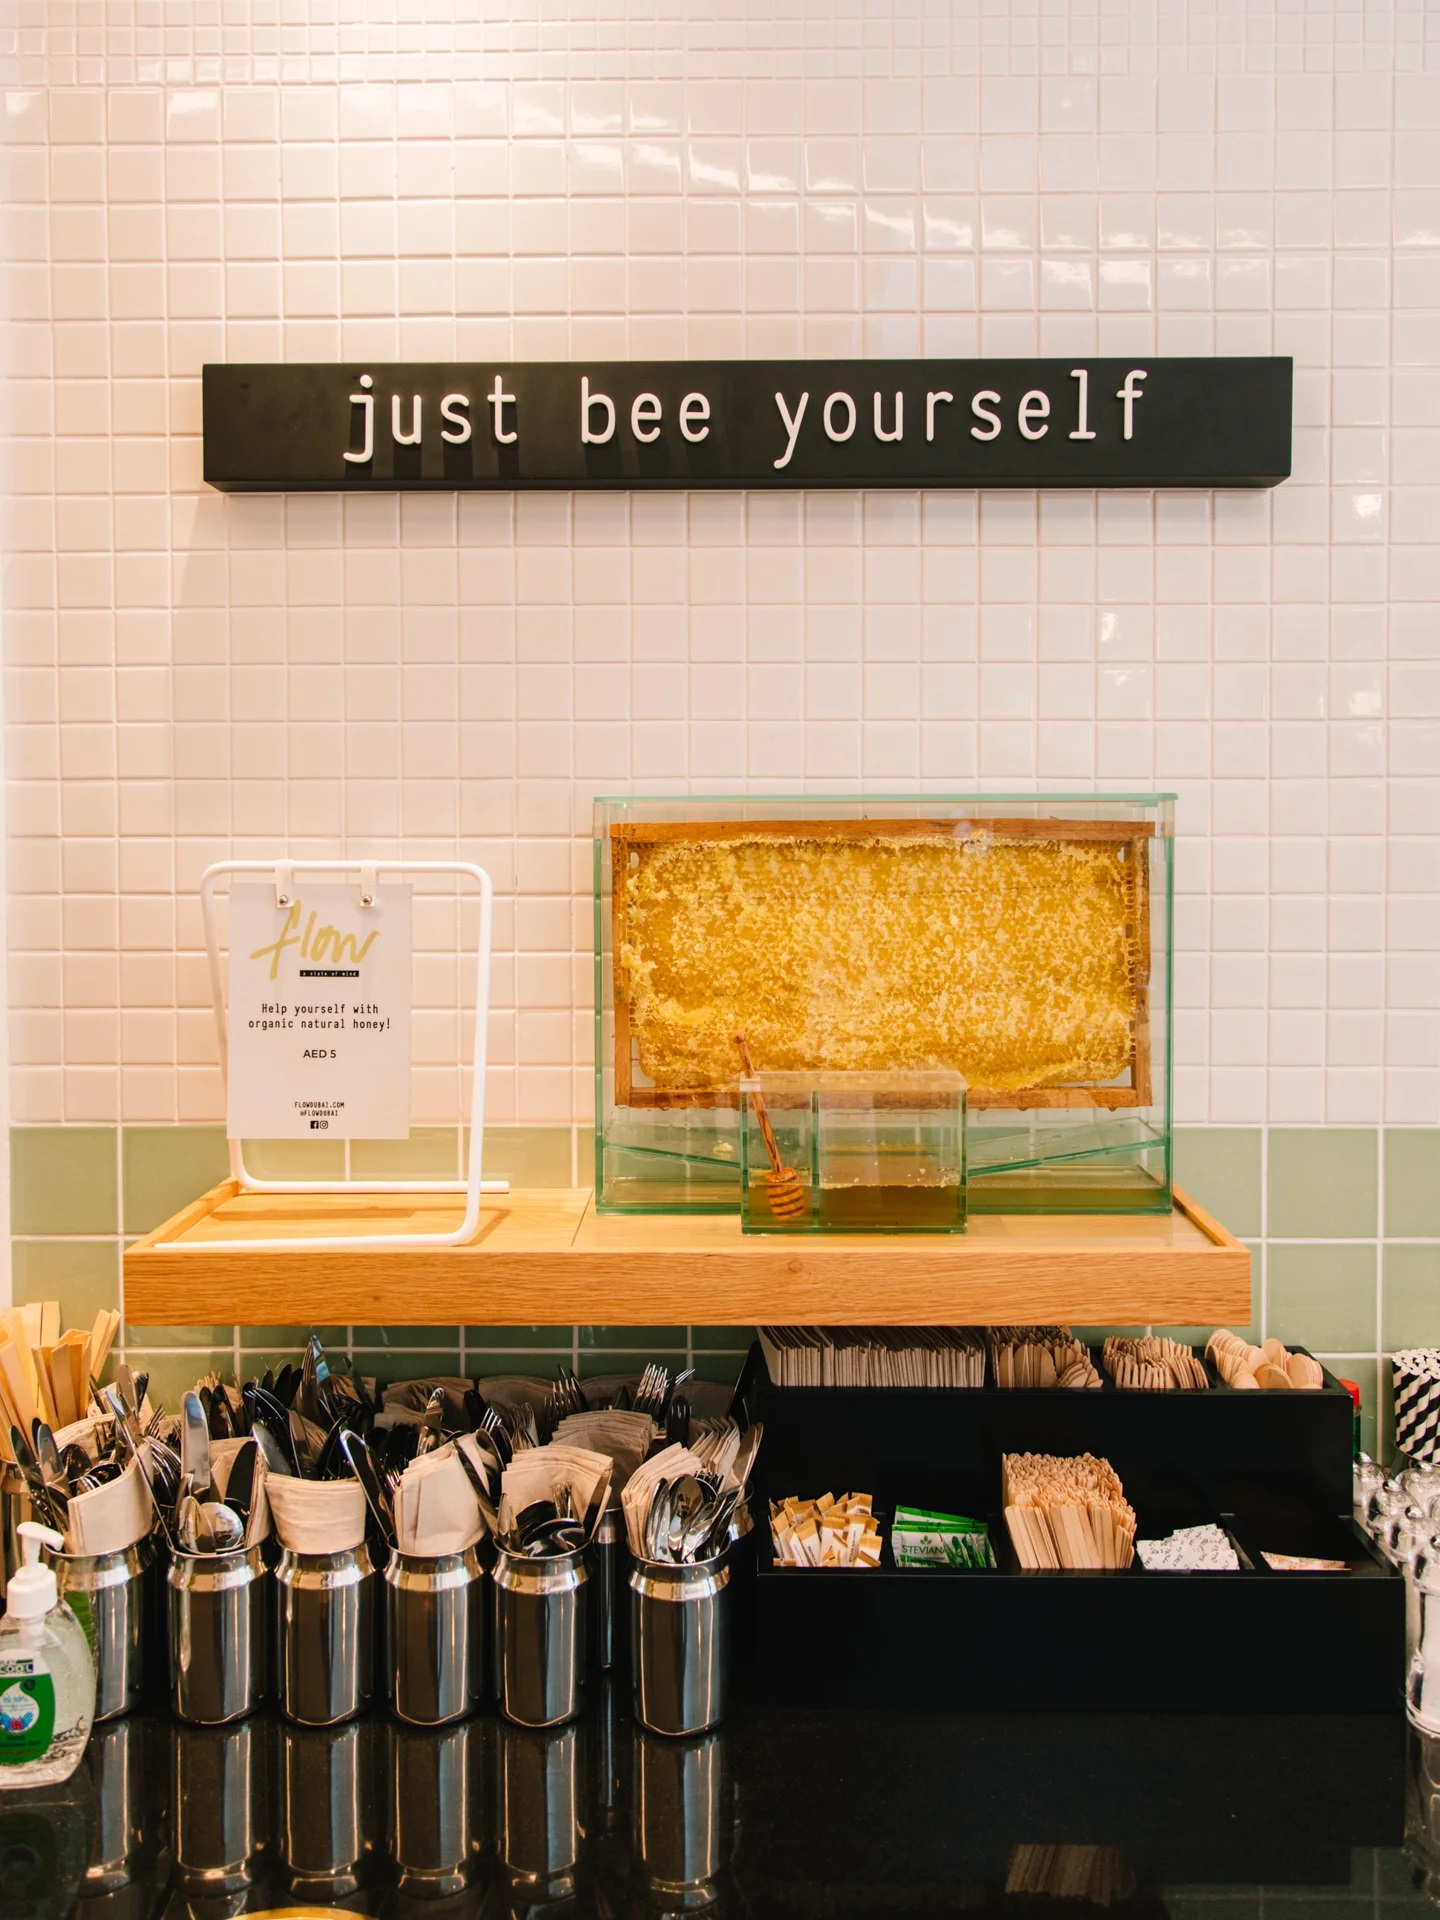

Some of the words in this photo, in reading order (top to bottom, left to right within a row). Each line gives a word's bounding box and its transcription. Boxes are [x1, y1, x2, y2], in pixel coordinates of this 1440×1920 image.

[343, 374, 518, 463] just
[581, 376, 711, 444] bee
[773, 369, 1148, 469] yourself
[250, 899, 381, 981] flow
[261, 1003, 288, 1015] Help
[294, 1003, 346, 1015] yourself
[353, 1003, 379, 1014] with
[248, 1018, 294, 1031] organic
[301, 1018, 345, 1029] natural
[353, 1018, 391, 1032] honey!
[303, 1049, 327, 1059] AED
[330, 1049, 337, 1059] 5
[294, 1101, 345, 1109] FLOWDUBAI.COM
[300, 1109, 338, 1117] @FLOWDUBAI
[902, 1545, 947, 1556] STEVIANA
